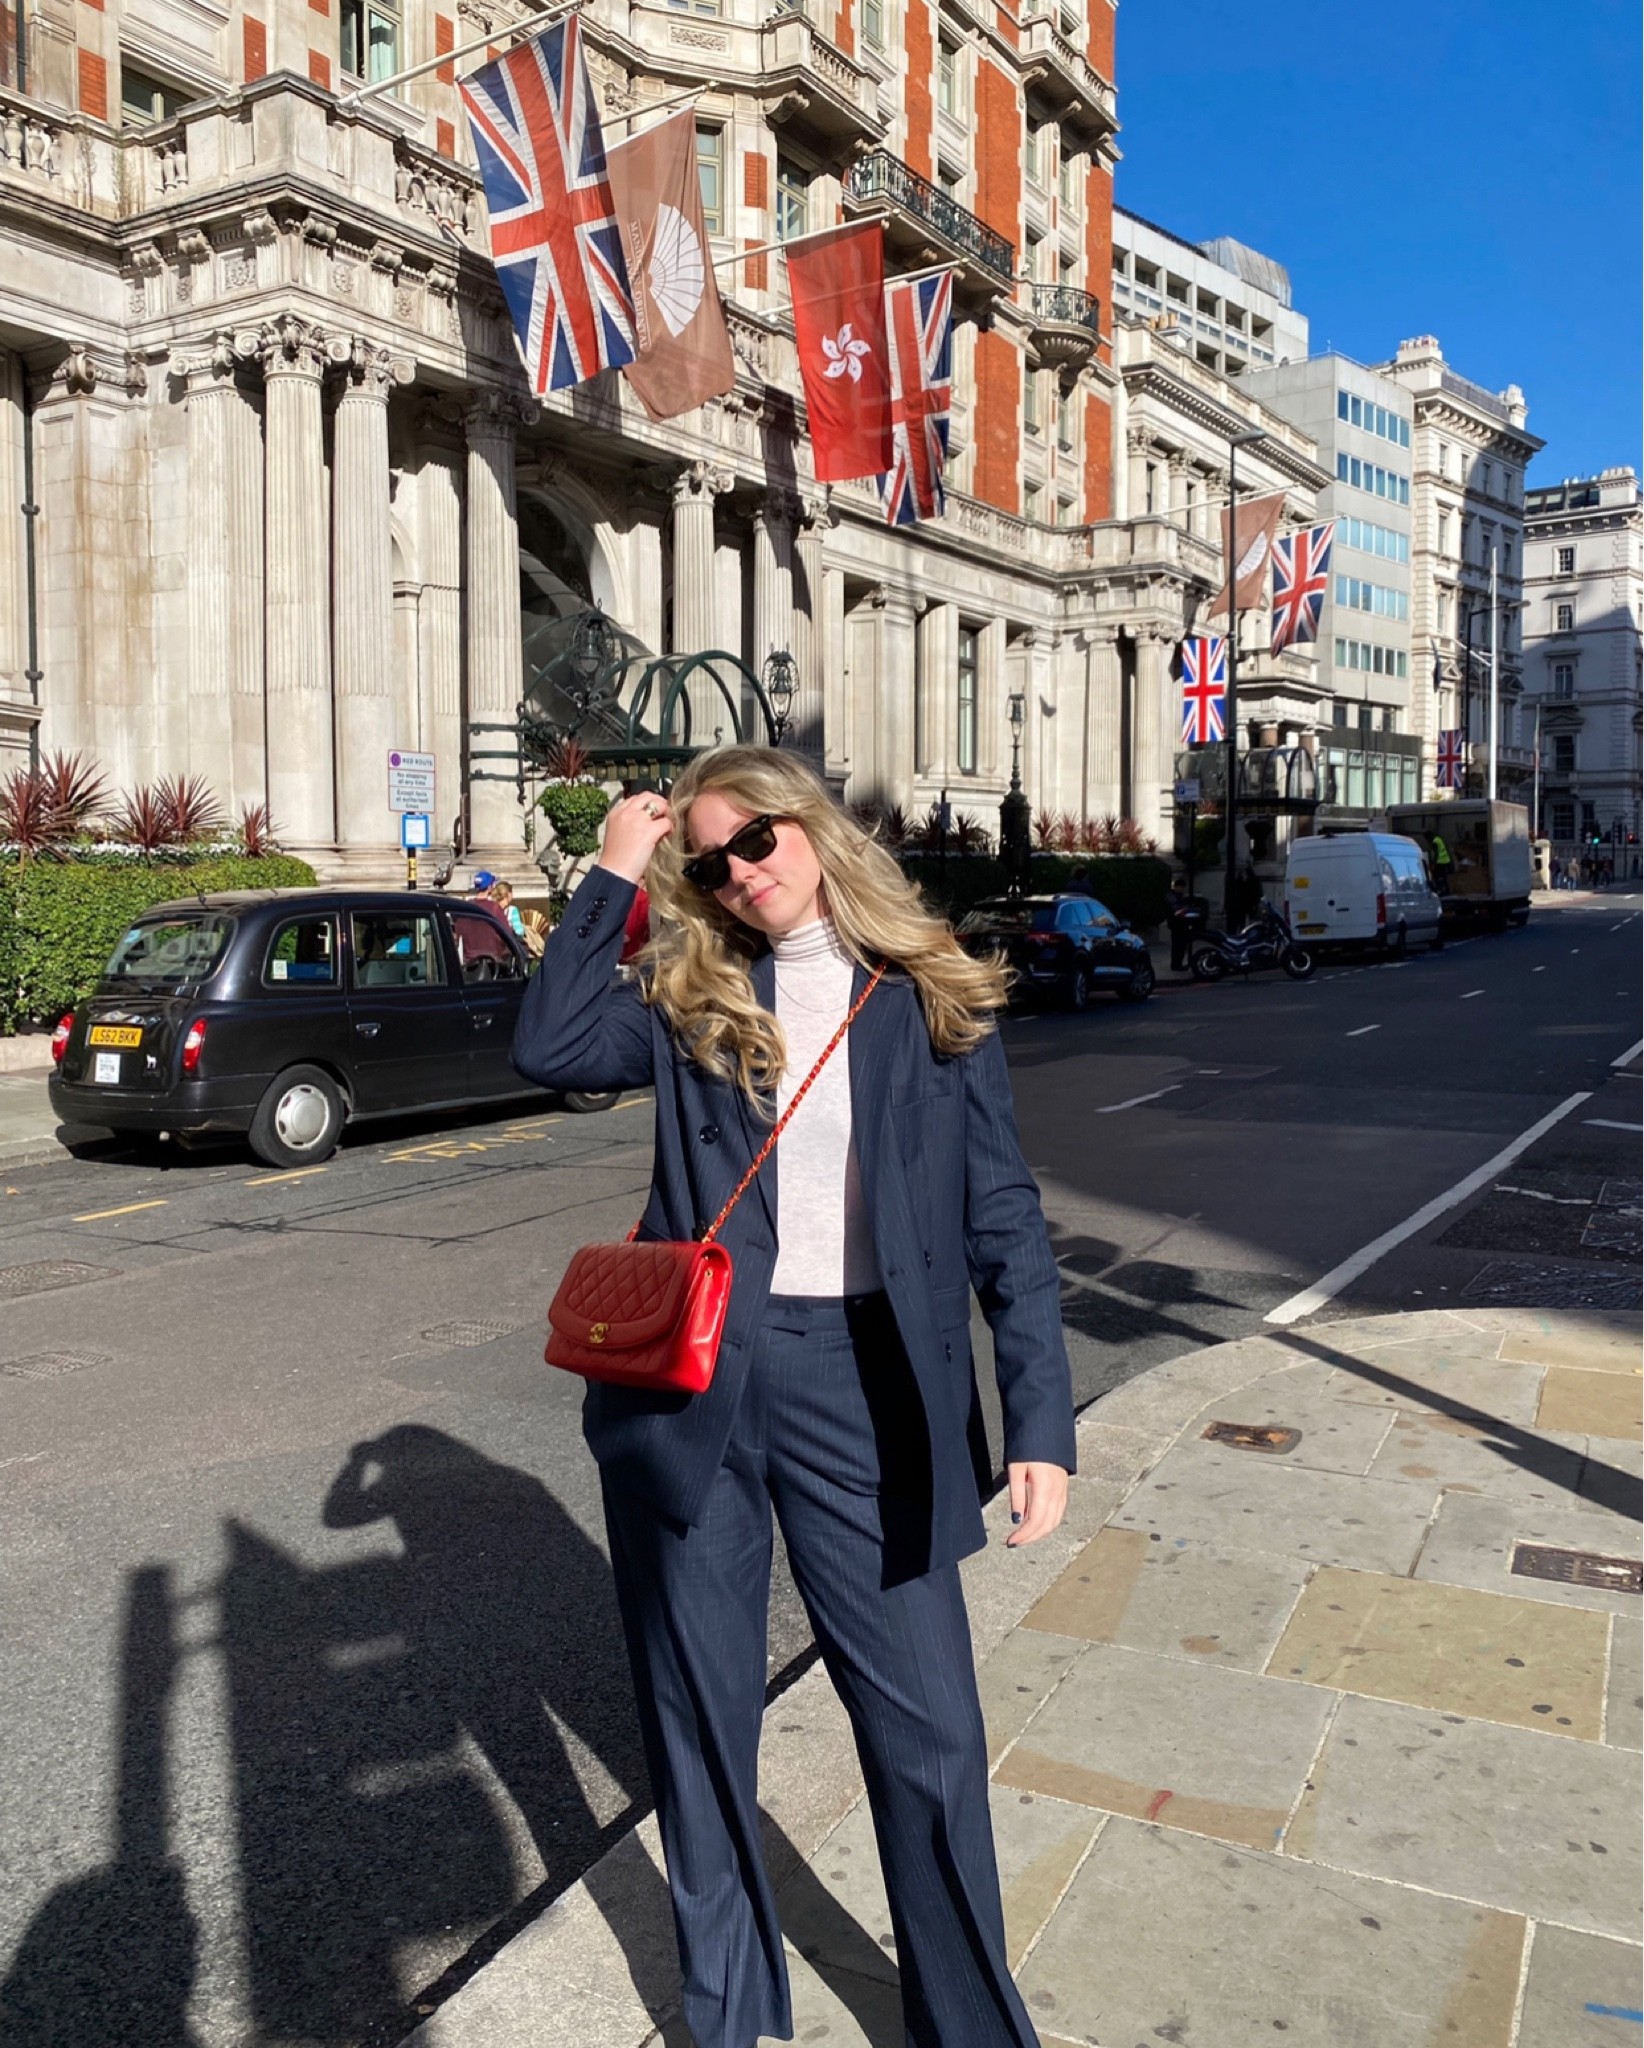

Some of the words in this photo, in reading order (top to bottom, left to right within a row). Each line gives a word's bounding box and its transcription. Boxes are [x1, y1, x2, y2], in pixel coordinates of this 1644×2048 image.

[631, 219, 643, 287] MANDN
[634, 290, 648, 350] ORIENTAL
[402, 757, 414, 765] RED
[415, 758, 433, 767] ROUTE
[397, 789, 414, 797] Except
[94, 1028, 118, 1043] LS62
[118, 1029, 139, 1045] BKK
